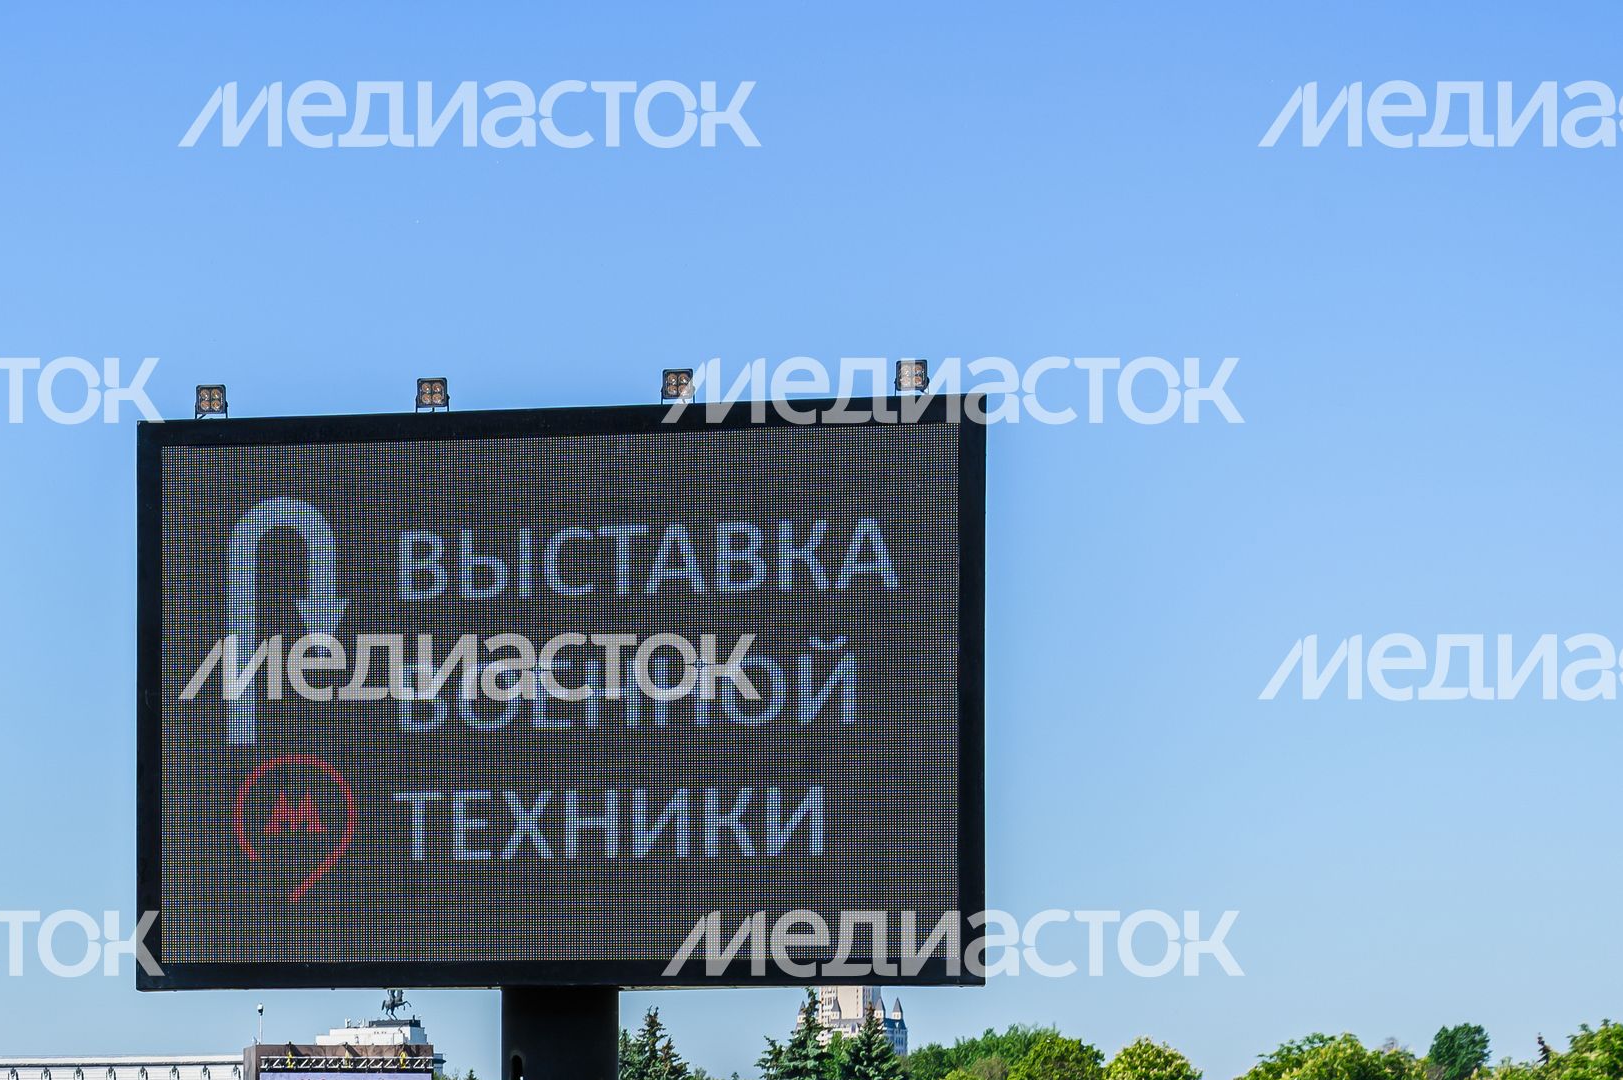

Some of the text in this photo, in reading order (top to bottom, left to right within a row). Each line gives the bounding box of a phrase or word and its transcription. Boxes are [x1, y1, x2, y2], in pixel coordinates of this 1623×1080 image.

[397, 517, 899, 601] ВЫСТАВКА
[399, 635, 860, 733] ВОЕННОЙ
[394, 784, 825, 862] ТЕХНИКИ
